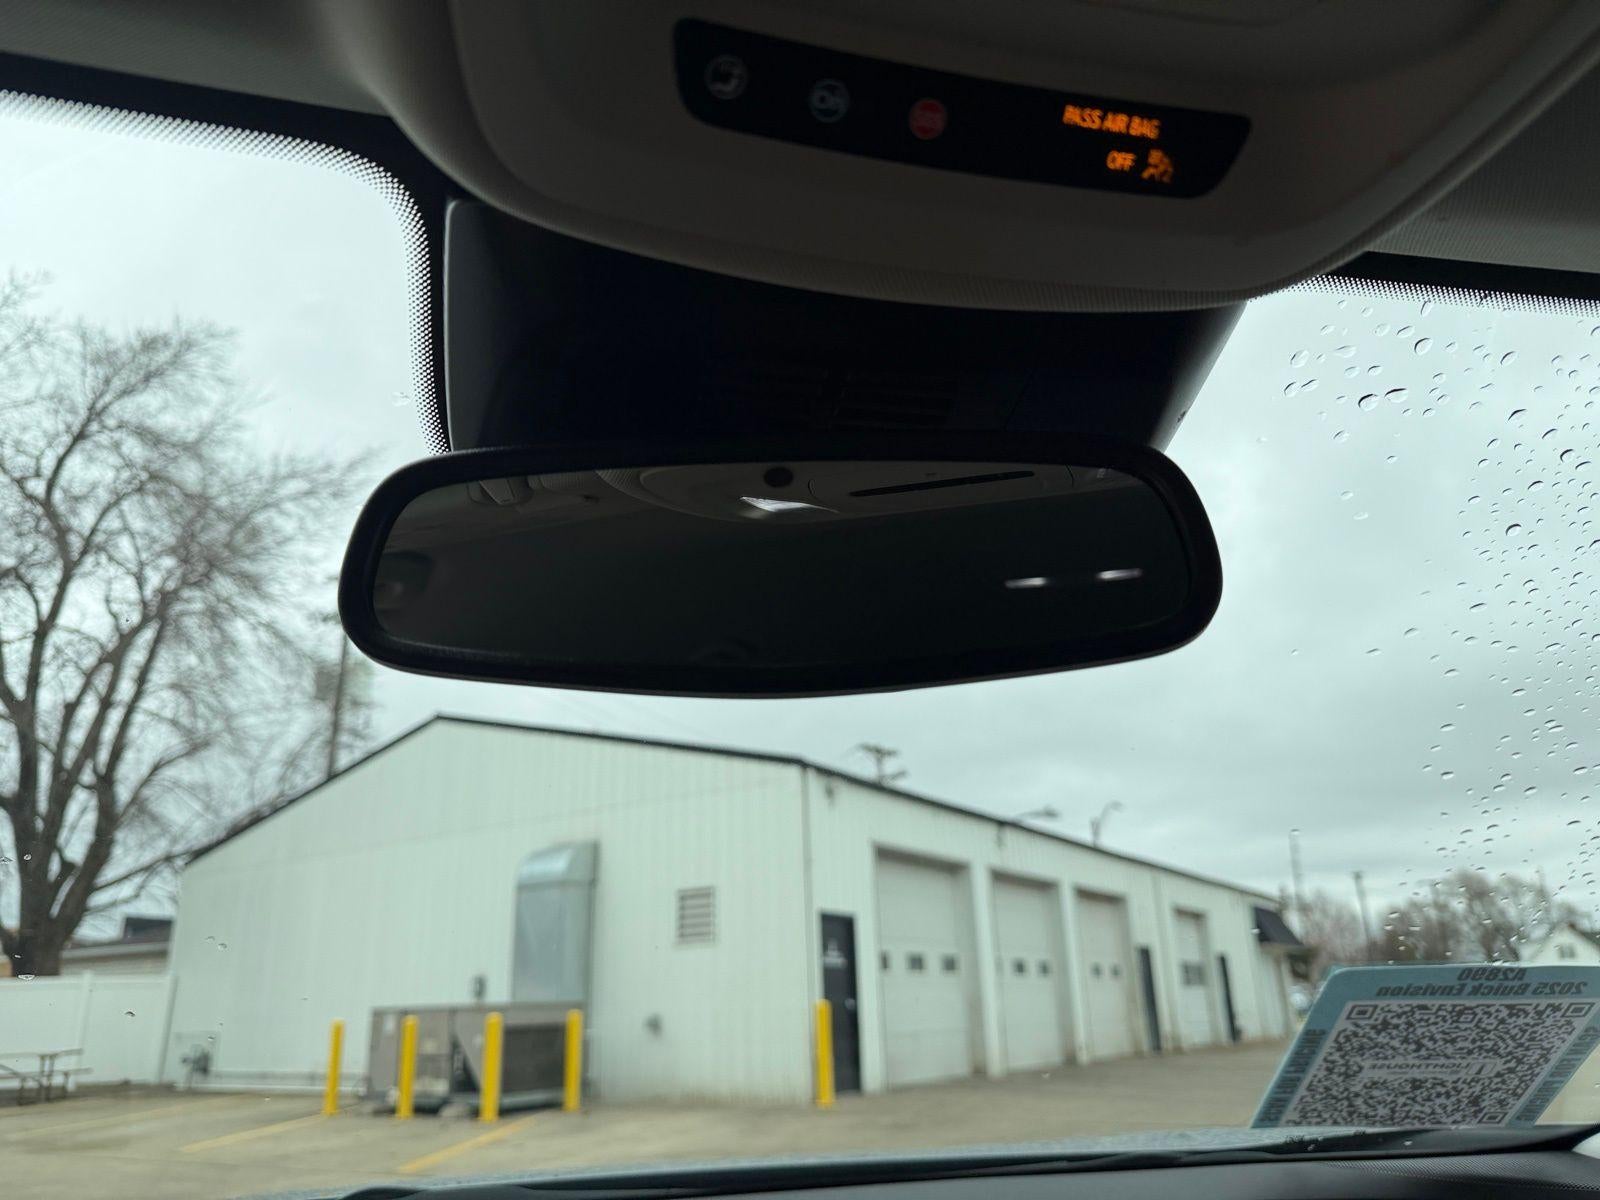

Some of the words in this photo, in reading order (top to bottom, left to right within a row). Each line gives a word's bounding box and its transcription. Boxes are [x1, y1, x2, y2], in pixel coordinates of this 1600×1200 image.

[1102, 112, 1129, 134] AIR
[1129, 115, 1161, 139] BAG
[1106, 150, 1136, 171] OFF
